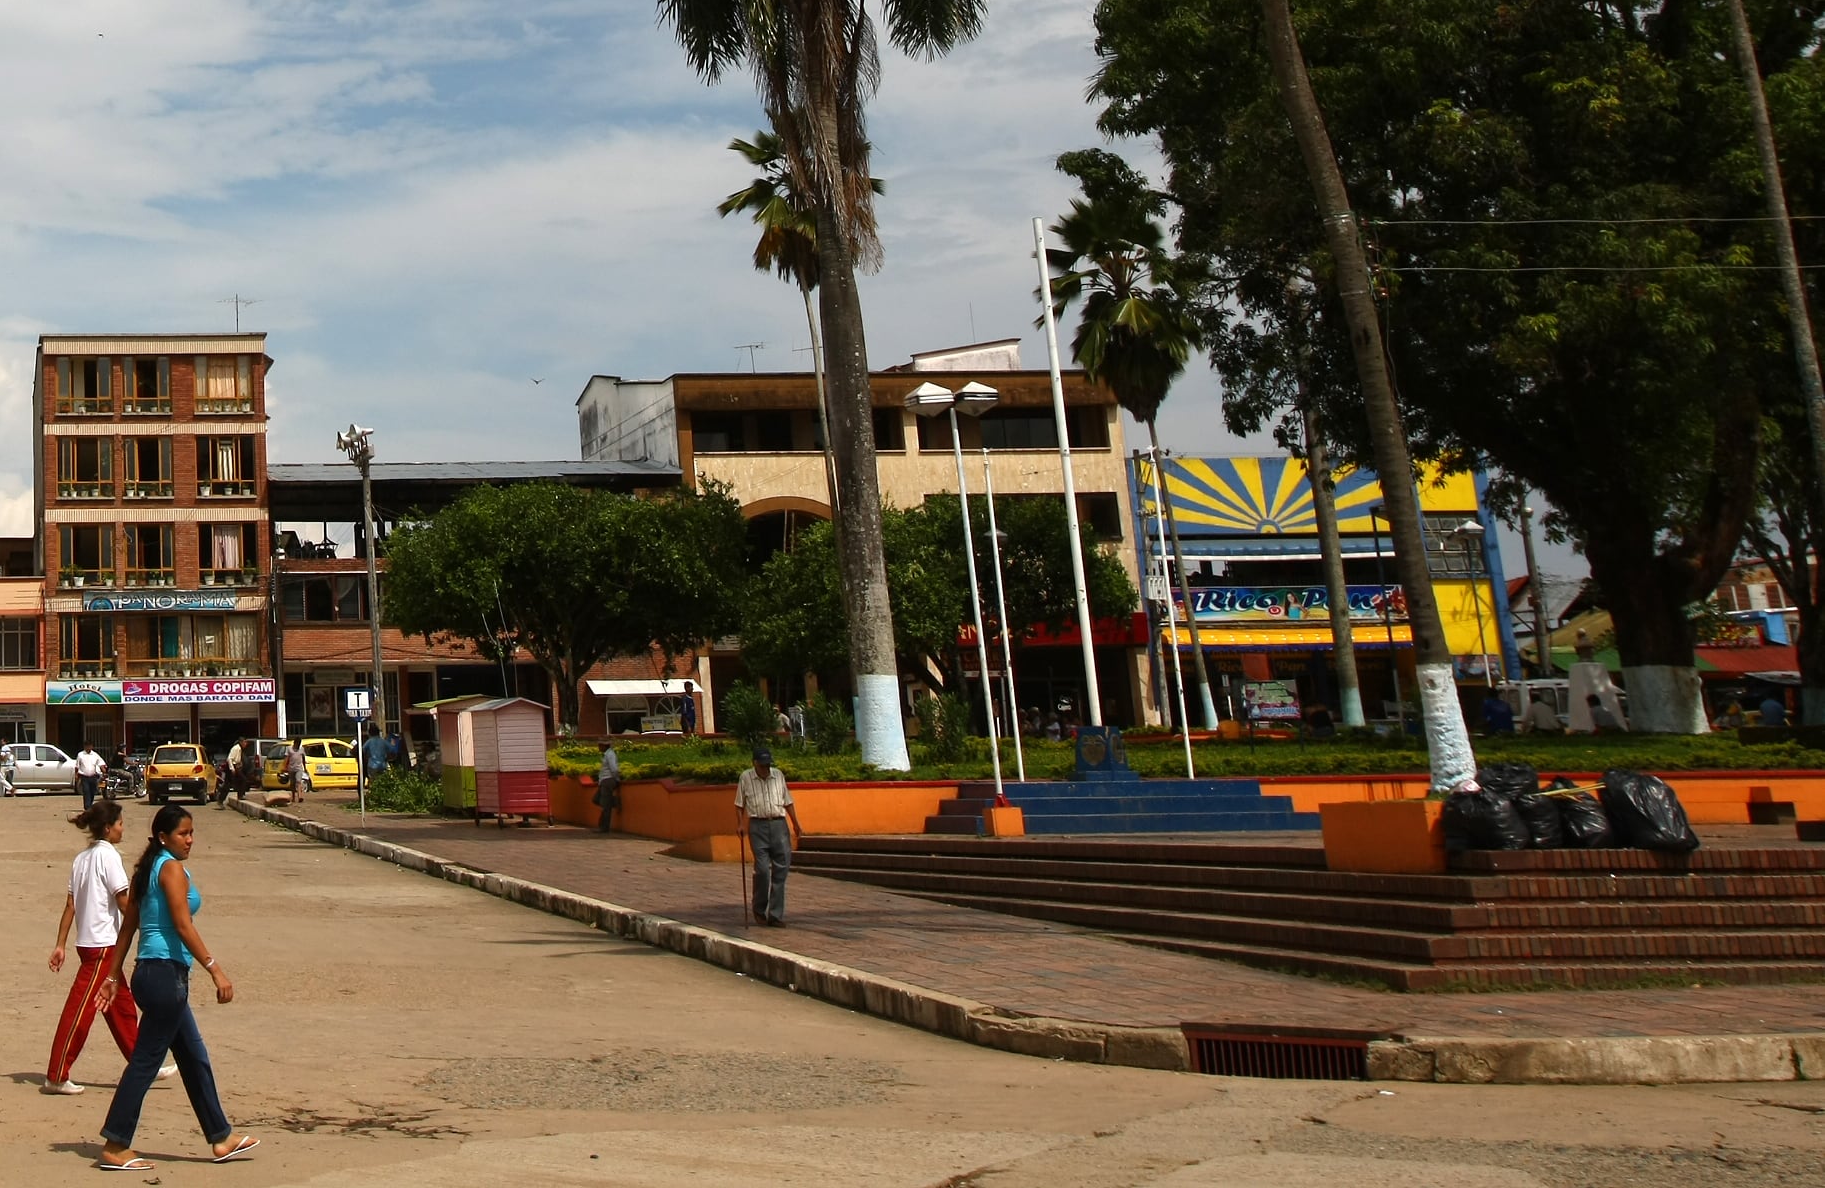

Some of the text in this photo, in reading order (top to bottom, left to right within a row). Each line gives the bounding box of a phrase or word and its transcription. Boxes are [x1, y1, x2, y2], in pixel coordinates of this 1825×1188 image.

[117, 593, 234, 609] PANORAMA
[1195, 588, 1373, 613] Rico Pn
[68, 683, 101, 693] Hotel
[149, 681, 273, 694] DROGAS COPIFAM
[354, 693, 362, 708] T
